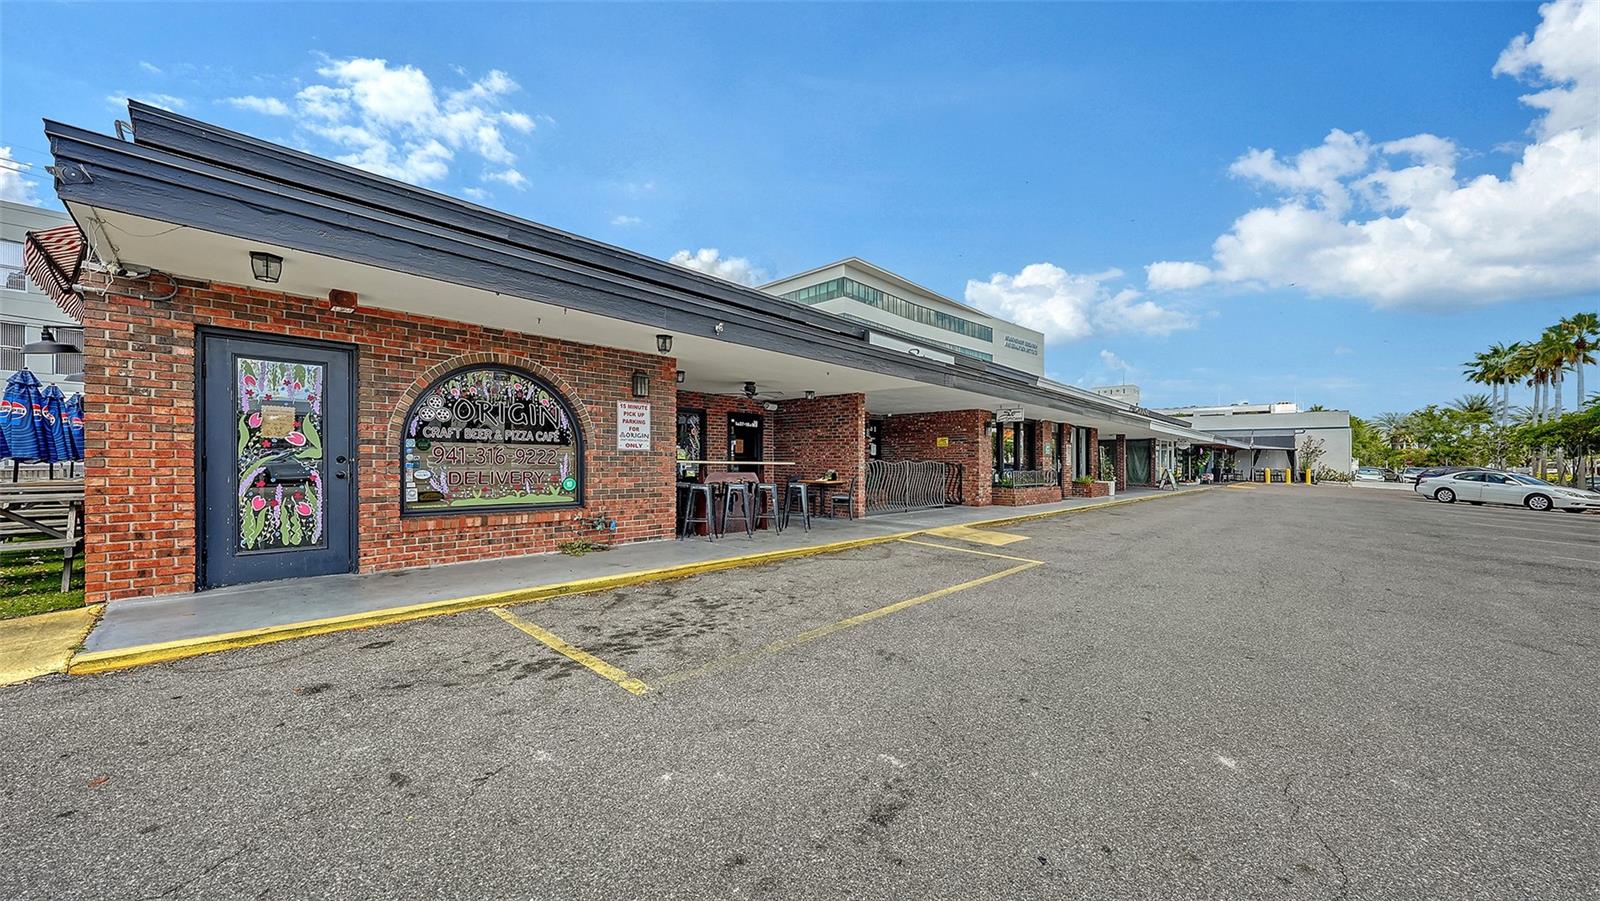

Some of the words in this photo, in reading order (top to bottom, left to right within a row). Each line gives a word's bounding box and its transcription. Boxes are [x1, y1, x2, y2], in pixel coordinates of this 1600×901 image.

[453, 397, 561, 429] ORIGIN
[422, 426, 461, 439] CRAFT
[464, 428, 492, 440] BEER
[494, 429, 504, 441] &
[505, 430, 534, 441] PIZZA
[432, 446, 557, 465] 941-316-9222
[448, 470, 545, 486] DELIVERY
